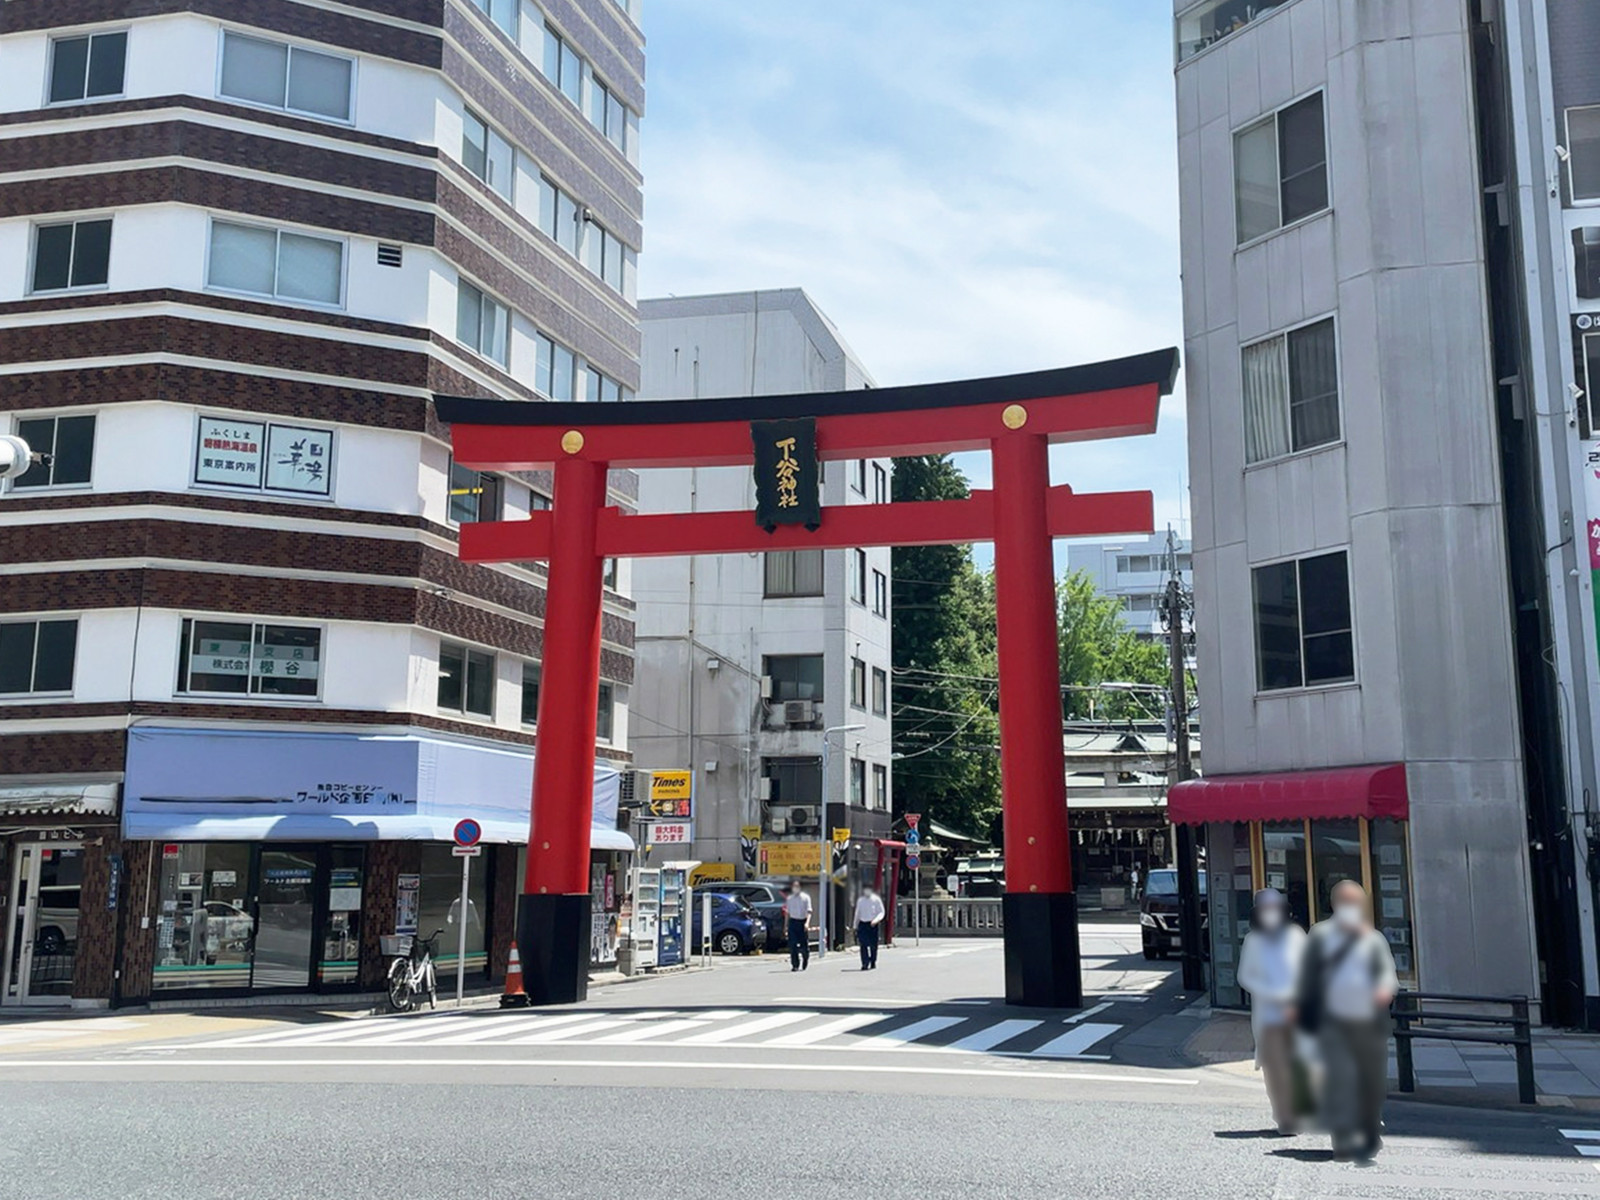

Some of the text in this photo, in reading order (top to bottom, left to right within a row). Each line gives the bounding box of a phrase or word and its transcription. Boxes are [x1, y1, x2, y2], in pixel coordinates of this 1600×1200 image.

[211, 428, 251, 439] ふくしま
[203, 459, 256, 473] 東京案内所
[775, 437, 801, 508] 下谷神社
[652, 776, 686, 788] Times
[655, 825, 684, 834] 最大料金
[655, 833, 684, 842] あります
